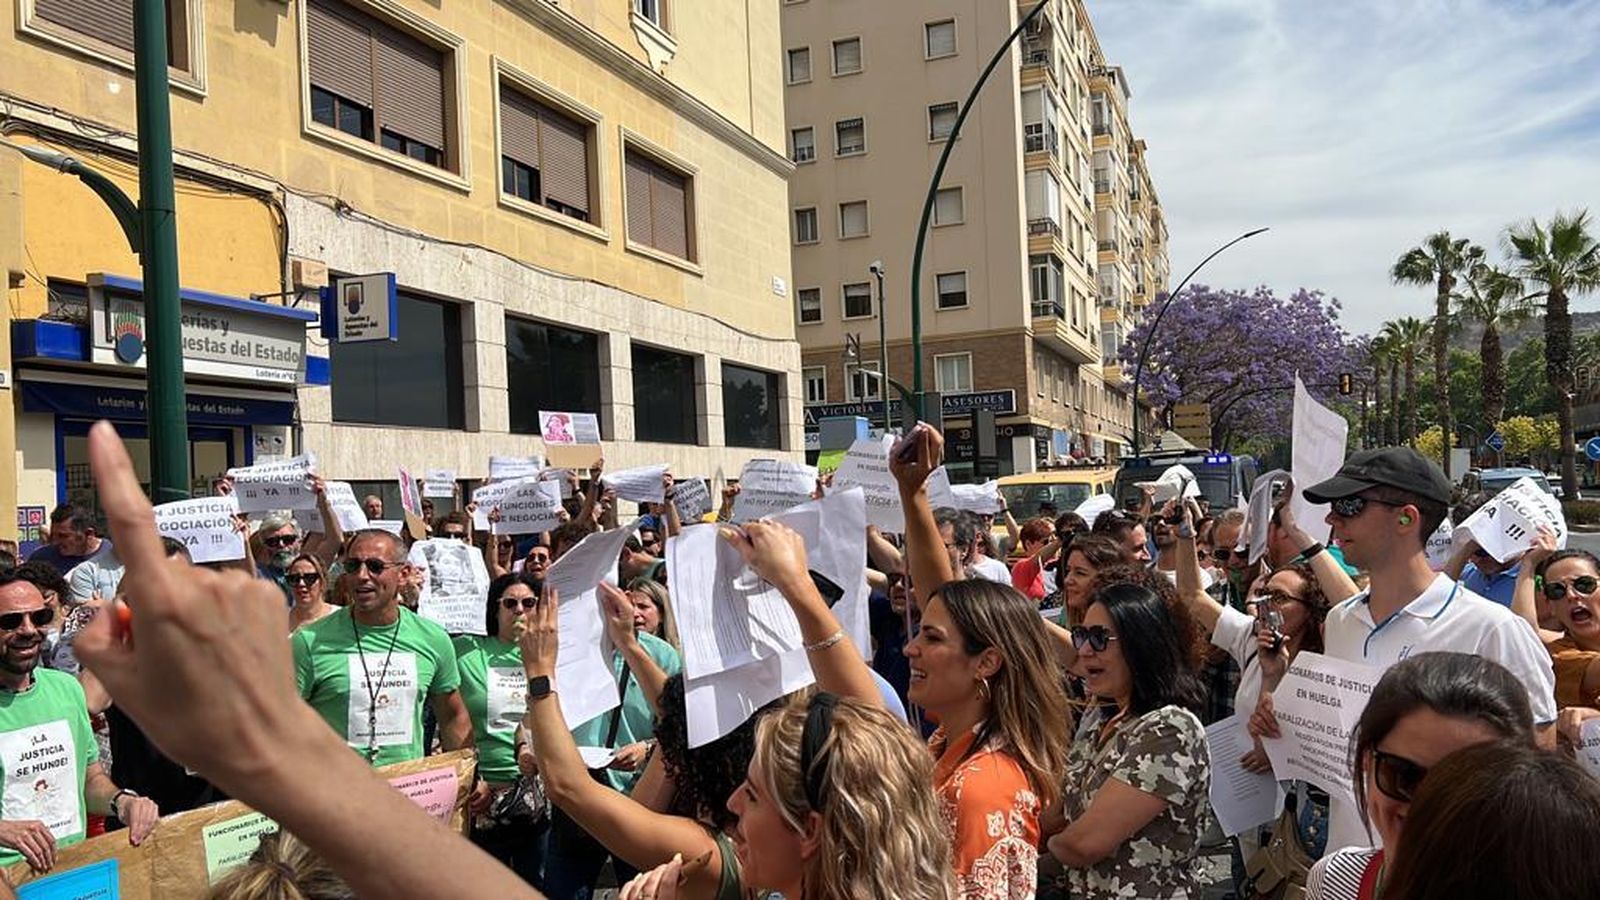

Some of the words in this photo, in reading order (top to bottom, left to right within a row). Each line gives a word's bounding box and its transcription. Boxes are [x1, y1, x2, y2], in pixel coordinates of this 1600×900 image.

[180, 312, 217, 329] erías
[220, 320, 230, 336] y
[183, 337, 226, 354] estas
[231, 340, 251, 357] del
[255, 343, 300, 363] Estado
[820, 404, 873, 416] VICTORIA
[263, 488, 280, 496] YA
[517, 489, 535, 497] LAS
[167, 503, 233, 517] JUSTICIA
[509, 512, 554, 523] NEGOCIA
[1505, 523, 1526, 540] !!!
[181, 536, 200, 545] YA
[211, 534, 223, 544] !!!
[1325, 674, 1337, 686] DE
[1296, 687, 1308, 700] EN
[1308, 690, 1342, 708] HUELGA
[1326, 726, 1338, 738] DE
[19, 744, 65, 762] JUSTICIA
[16, 766, 30, 777] SE
[32, 757, 69, 773] HUNDE!
